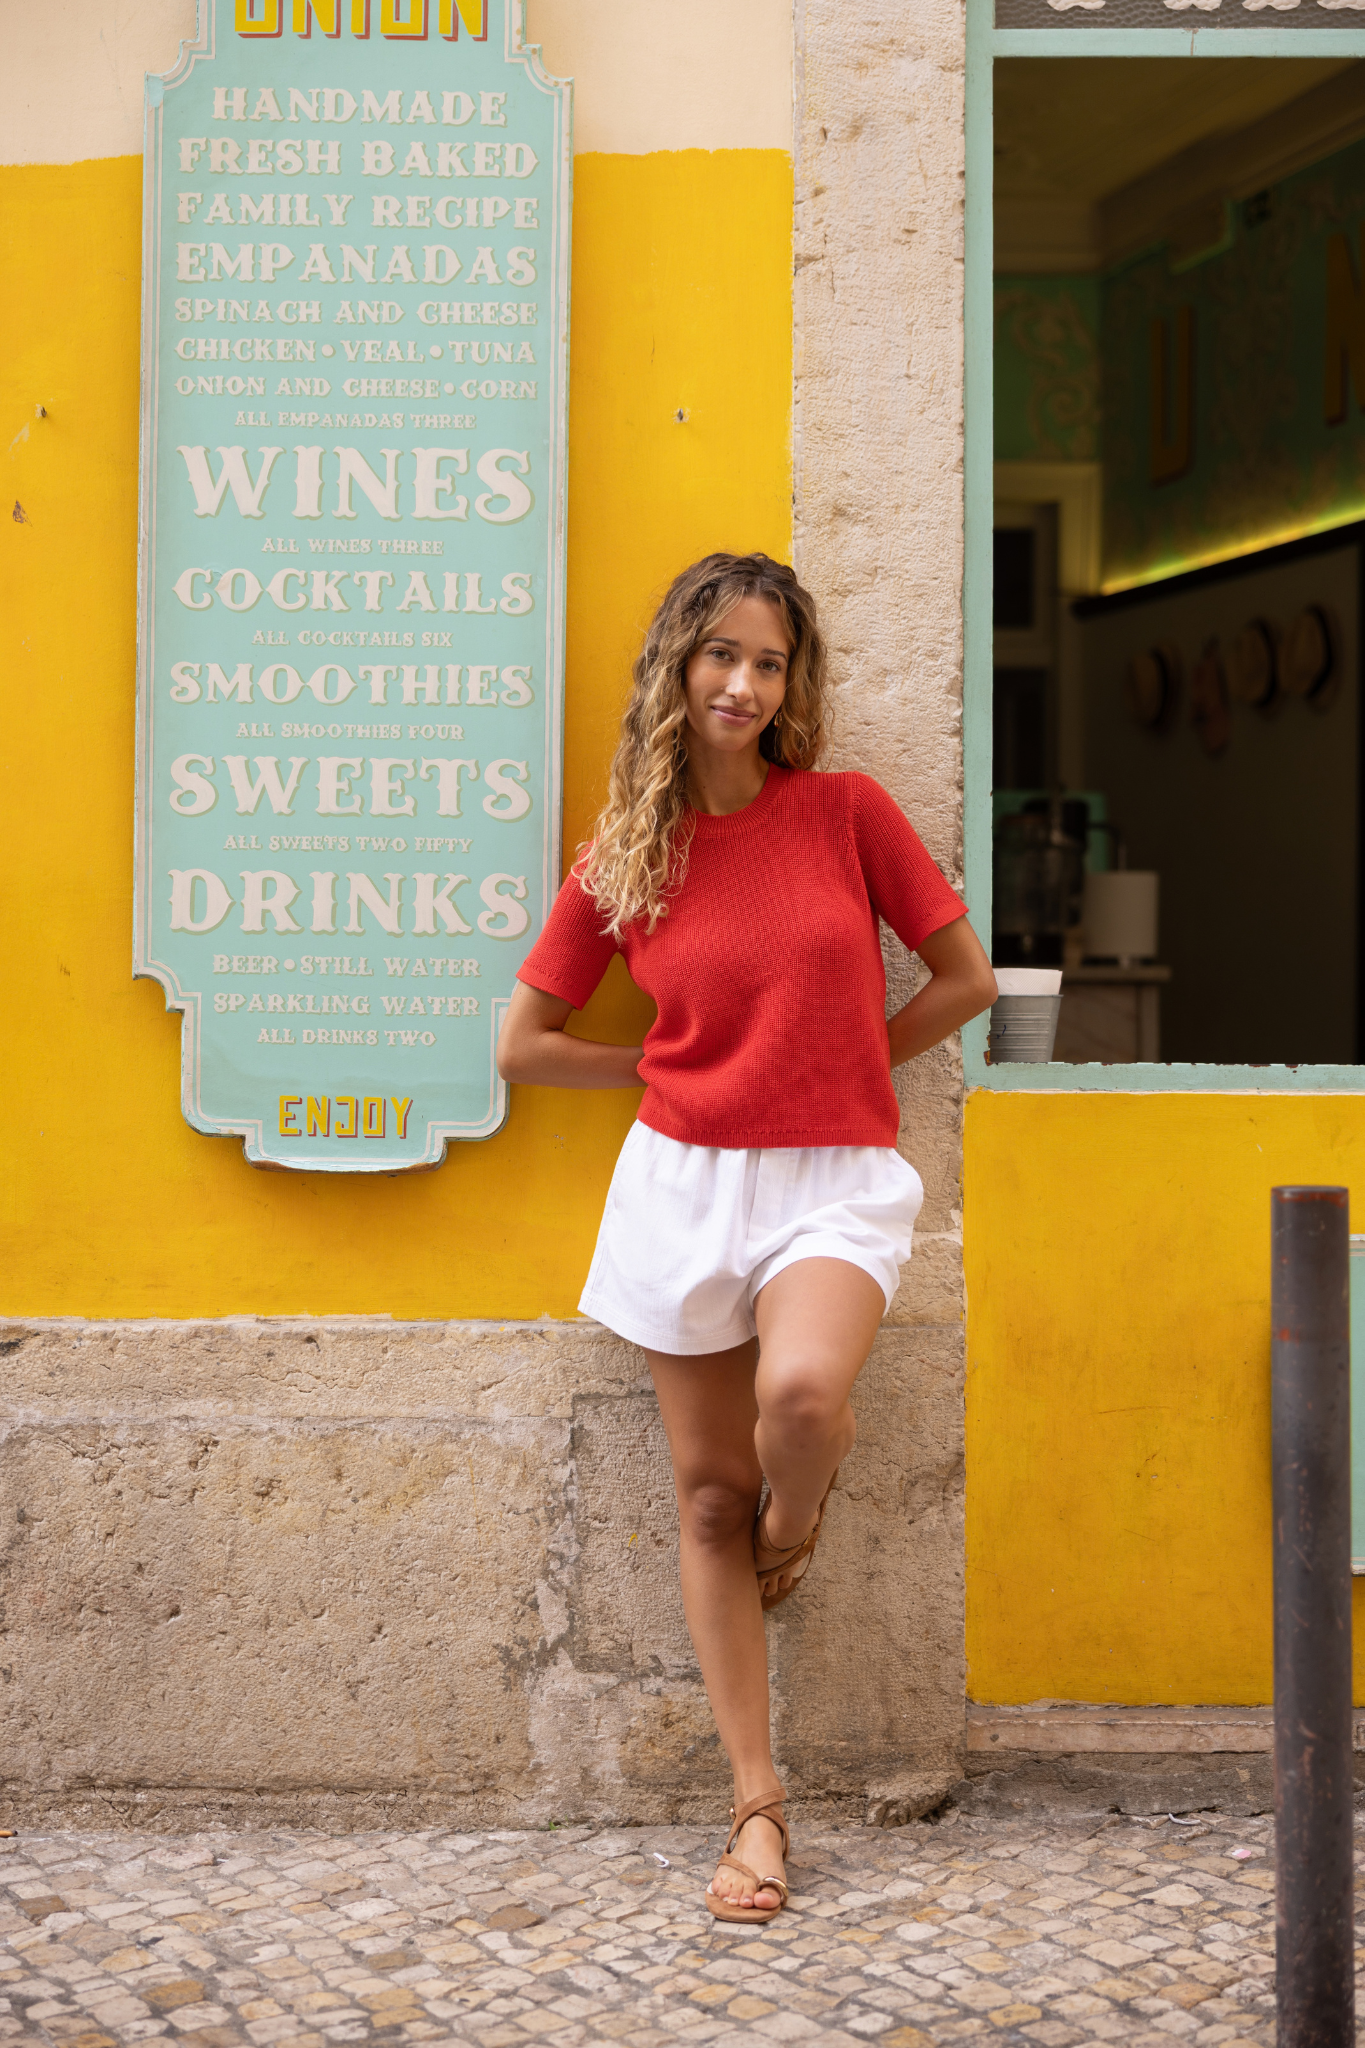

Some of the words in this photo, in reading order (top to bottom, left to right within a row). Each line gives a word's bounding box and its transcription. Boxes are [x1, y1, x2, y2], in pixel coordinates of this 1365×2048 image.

[212, 86, 508, 127] HANDMADE
[178, 137, 342, 176] FRESH
[361, 141, 539, 179] BAKED
[177, 193, 354, 227] FAMILY
[371, 195, 540, 229] RECIPE
[176, 242, 538, 287] EMPANADAS
[174, 297, 322, 324] SPINACH
[335, 301, 405, 325] AND
[416, 302, 538, 326] CHEESE
[175, 338, 317, 362] CHICKEN
[340, 340, 425, 364] VEAL
[449, 341, 536, 364] TUNA
[174, 376, 266, 397] ONION
[274, 378, 333, 398] AND
[342, 379, 441, 399] CHEESE
[459, 380, 538, 400] CORN
[235, 411, 272, 427] ALL
[278, 412, 405, 429] EMPANADAS
[410, 414, 477, 430] THREE
[176, 445, 535, 525] WINES
[262, 538, 300, 554] ALL
[308, 539, 372, 555] WINES
[377, 540, 445, 556] THREE
[172, 567, 535, 617] COCKTAILS
[252, 630, 290, 646] ALL
[298, 631, 415, 648] COCKTAILS
[421, 632, 454, 648] SIX
[169, 661, 535, 709] SMOOTHIES
[237, 722, 275, 739] ALL
[281, 723, 402, 740] SMOOTHIES
[408, 725, 465, 741] FOUR
[169, 753, 533, 823] SWEETS
[223, 835, 262, 851] ALL
[269, 835, 350, 852] SWEETS
[356, 837, 408, 853] TWO
[414, 838, 473, 854] FIFTY
[167, 868, 530, 941] DRINKS
[212, 954, 280, 975] BEER
[300, 956, 374, 978] STILL
[383, 957, 482, 978] WATER
[212, 993, 371, 1016] SPARKLING
[380, 997, 481, 1017] WATER
[257, 1028, 296, 1045] ALL
[302, 1029, 379, 1046] DRINKS
[384, 1031, 438, 1048] TWO
[278, 1095, 413, 1139] ENJOY
